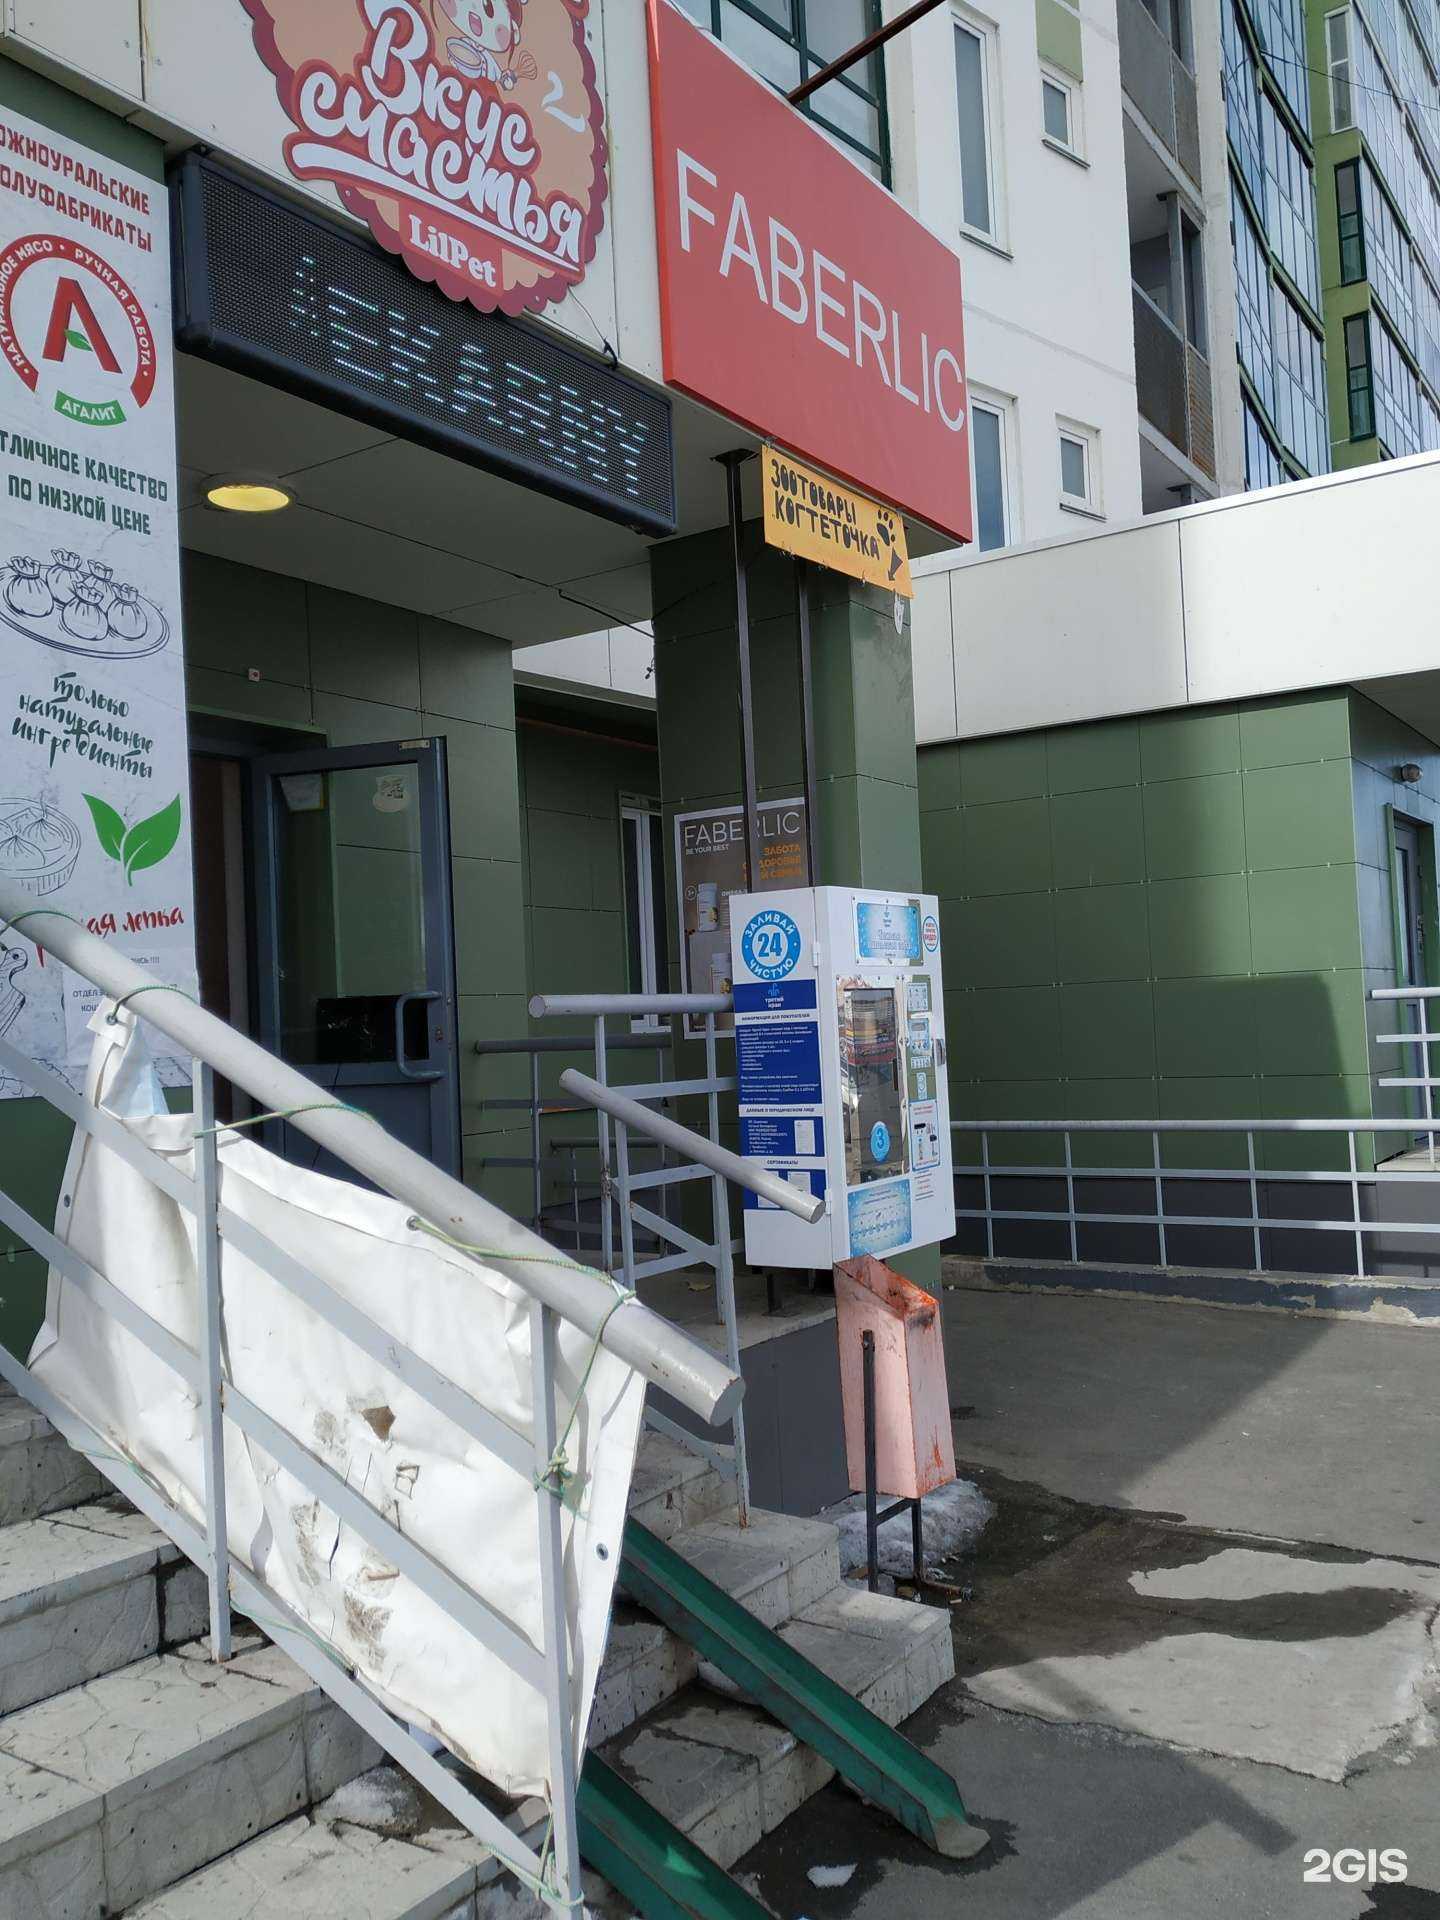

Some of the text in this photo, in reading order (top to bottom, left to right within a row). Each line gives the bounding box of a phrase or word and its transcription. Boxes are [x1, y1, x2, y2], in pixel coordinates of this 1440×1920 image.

[541, 70, 585, 132] 2
[408, 214, 497, 288] LilPet
[15, 239, 53, 261] МЯСО
[75, 248, 129, 300] РУЧНАЯ
[127, 304, 151, 365] РАБОТА
[677, 148, 965, 432] FABERLIC
[62, 399, 117, 421] АГАЛИТ
[8, 474, 151, 535] ПО НИЗКОЙ ЦЕНЕ
[85, 456, 168, 502] КАЧЕСТВО
[771, 458, 856, 526] ЗООТОВАРЫ
[775, 490, 880, 561] КОГТЕТОЧКА
[123, 907, 184, 933] лепка
[745, 913, 796, 938] ЗАЛИВАЙ
[757, 932, 783, 958] 24
[749, 958, 794, 979] ЧИСТУЮ
